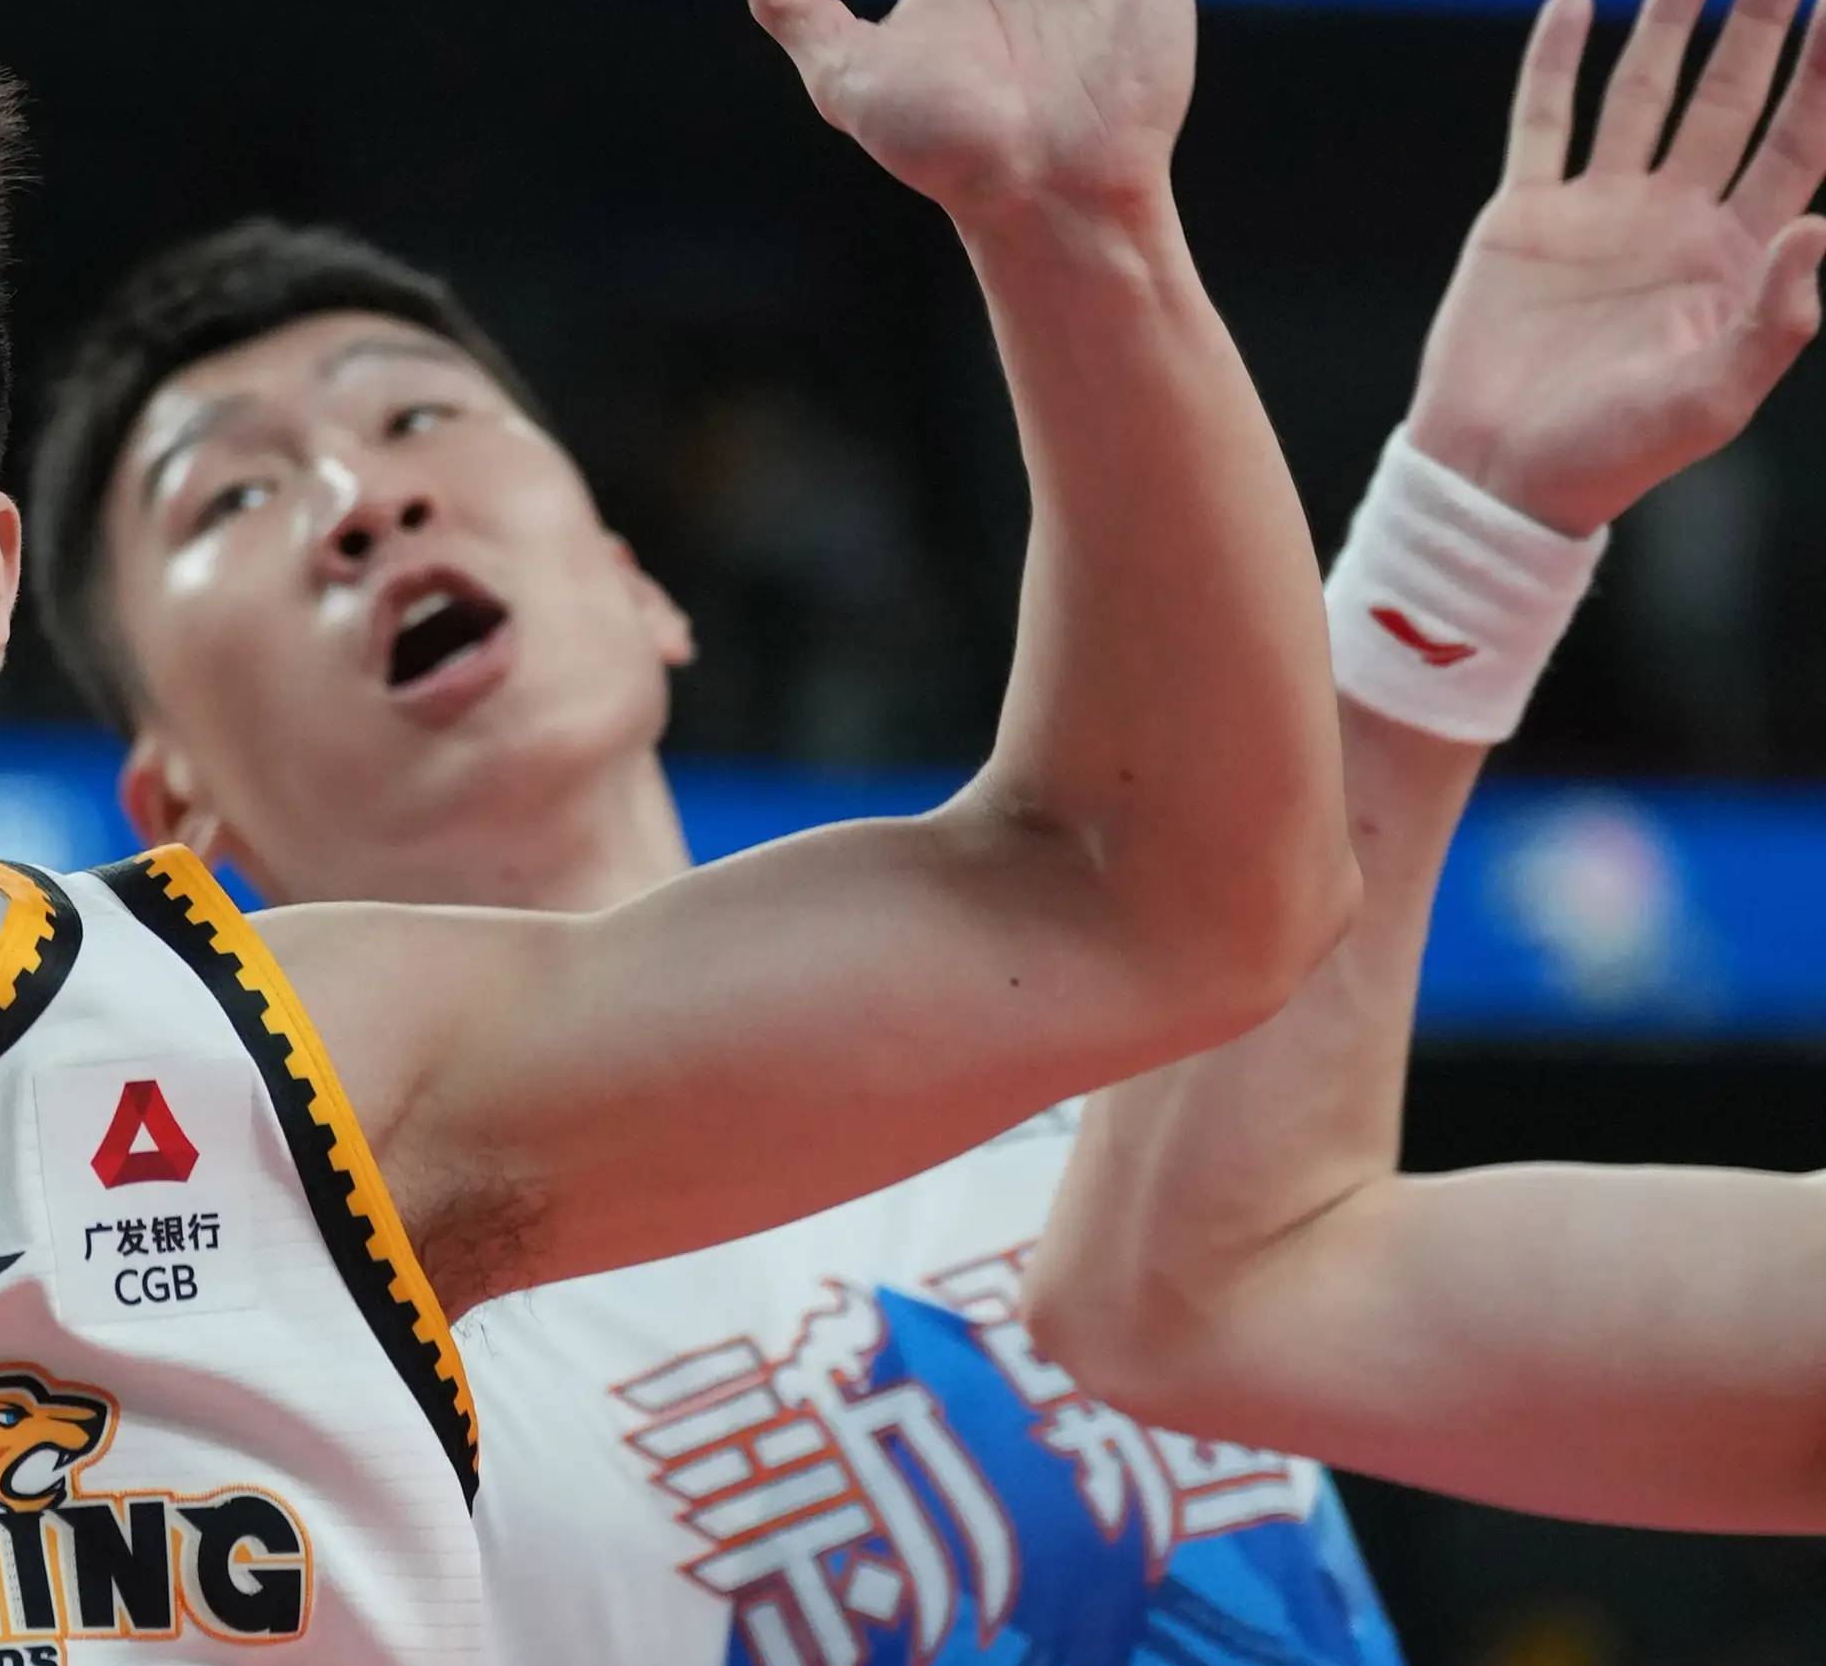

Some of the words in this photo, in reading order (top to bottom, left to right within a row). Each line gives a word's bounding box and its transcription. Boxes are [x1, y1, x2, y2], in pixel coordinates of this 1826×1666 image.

[84, 1212, 221, 1262] 广发银行
[114, 1264, 198, 1306] CGB
